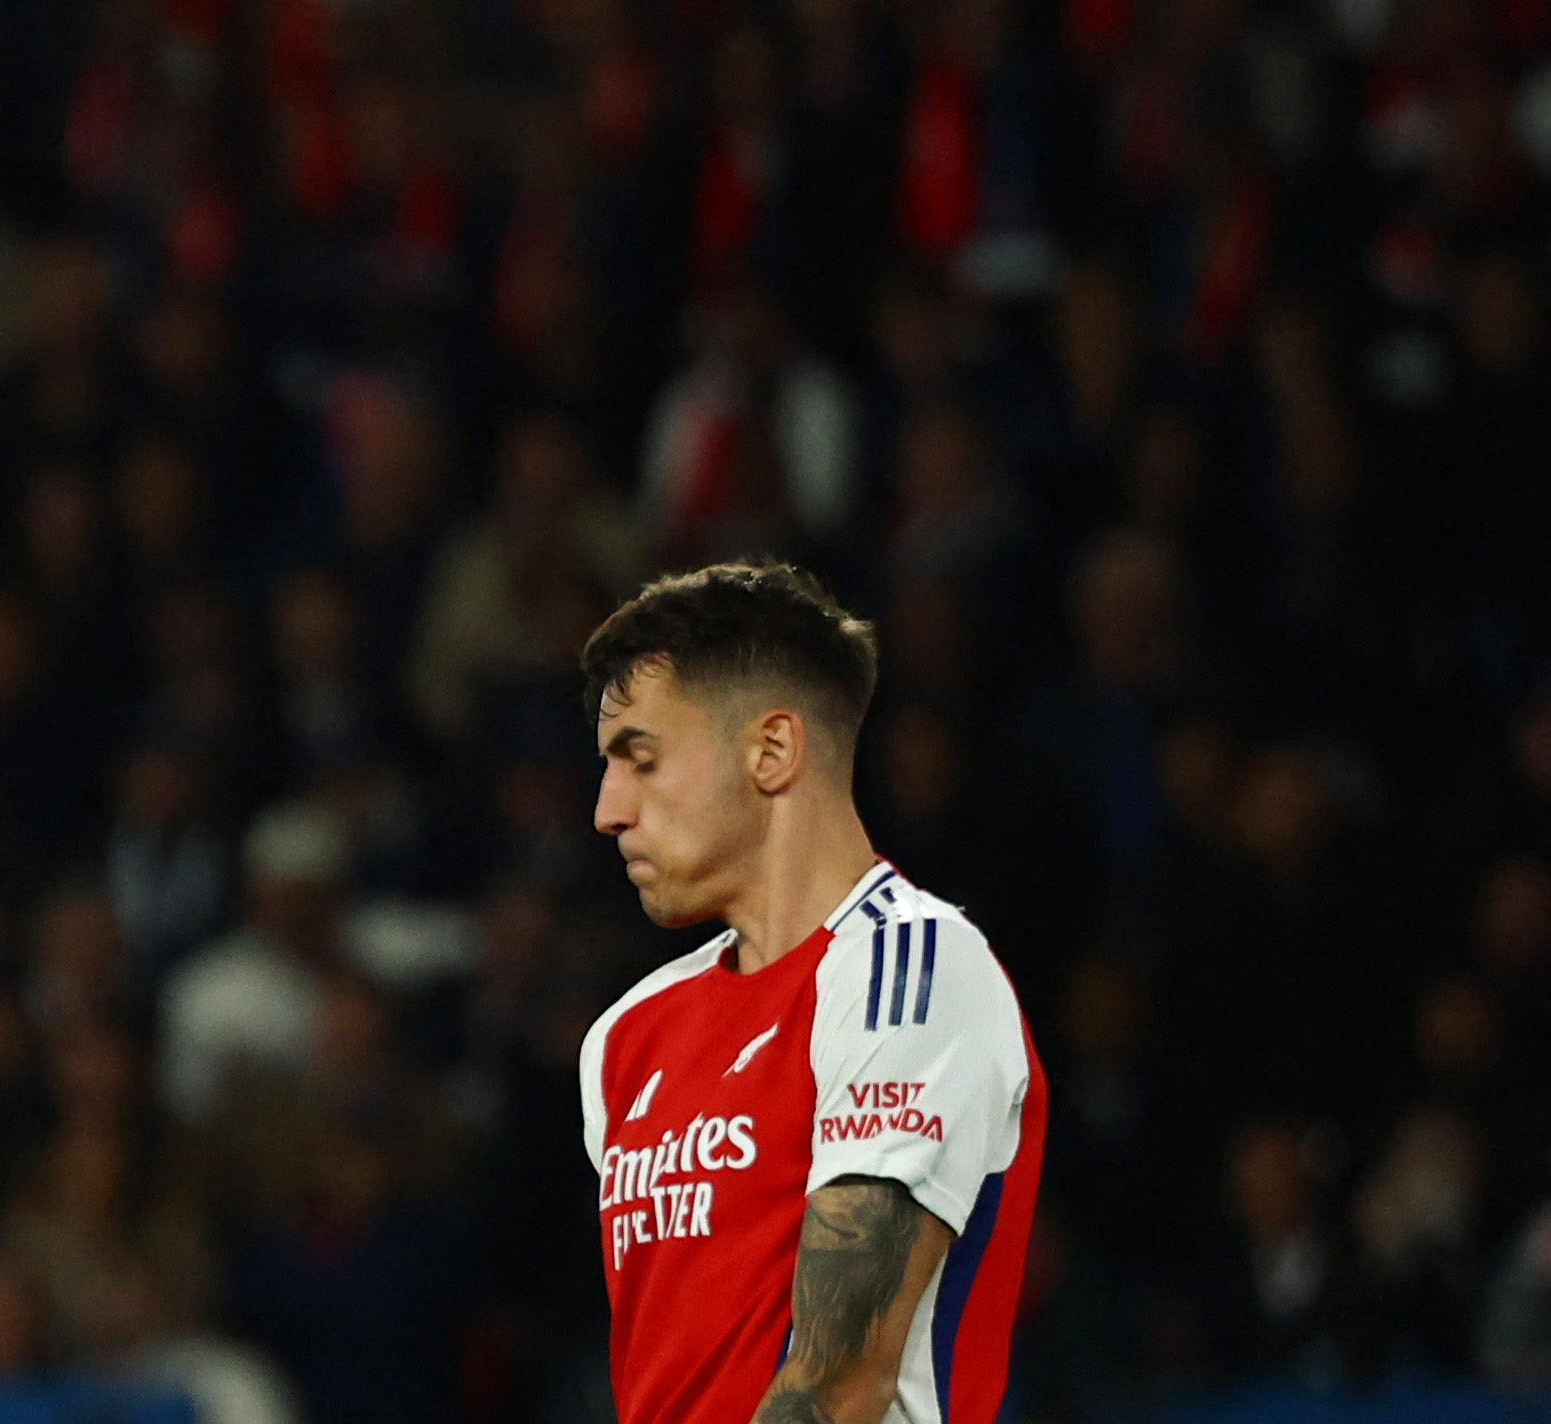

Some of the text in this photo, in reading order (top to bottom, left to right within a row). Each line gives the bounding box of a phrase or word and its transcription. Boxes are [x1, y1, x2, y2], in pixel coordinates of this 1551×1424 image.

[846, 1082, 925, 1109] VISIT
[819, 1108, 943, 1144] RWANDA
[599, 1111, 757, 1211] Emites
[634, 1182, 713, 1243] ETTER
